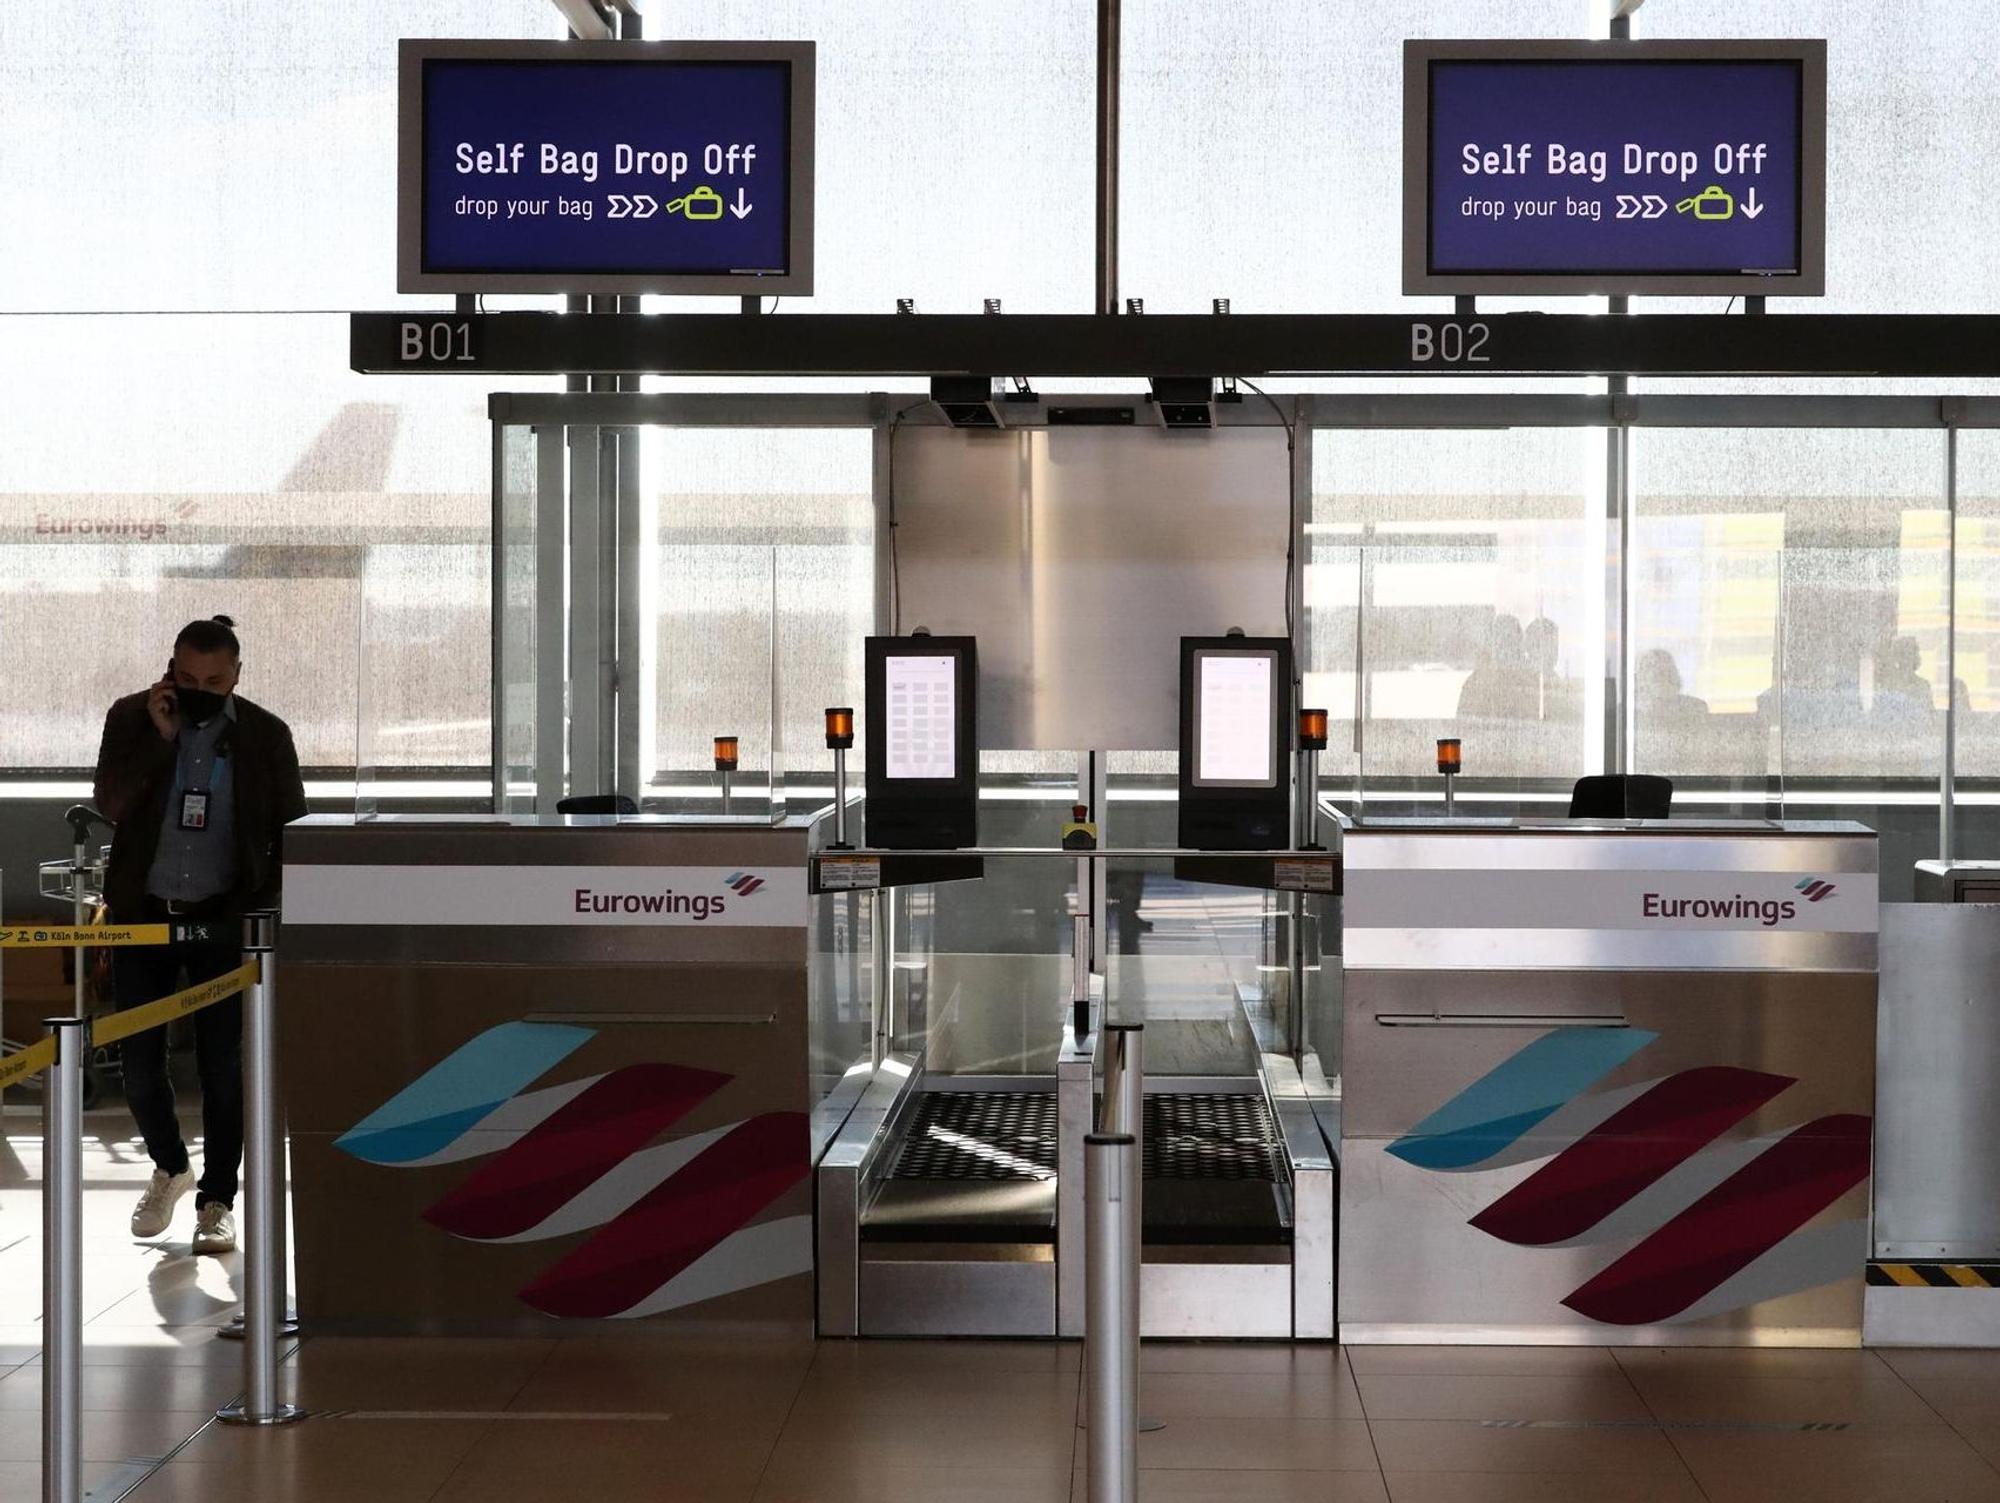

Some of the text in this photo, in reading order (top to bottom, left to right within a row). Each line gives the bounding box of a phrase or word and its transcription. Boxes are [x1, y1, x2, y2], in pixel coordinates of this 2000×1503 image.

[455, 142, 757, 183] Self Bag Drop Off
[1461, 142, 1768, 183] Self Bag Drop Off
[455, 195, 593, 221] drop your bag
[1461, 195, 1601, 222] drop your bag
[401, 322, 475, 361] B01
[1411, 322, 1490, 362] B02
[36, 513, 167, 539] Eurowings
[575, 889, 726, 921] Eurowings
[1643, 893, 1796, 926] Eurowings
[51, 929, 132, 942] Köln Bonn Airport
